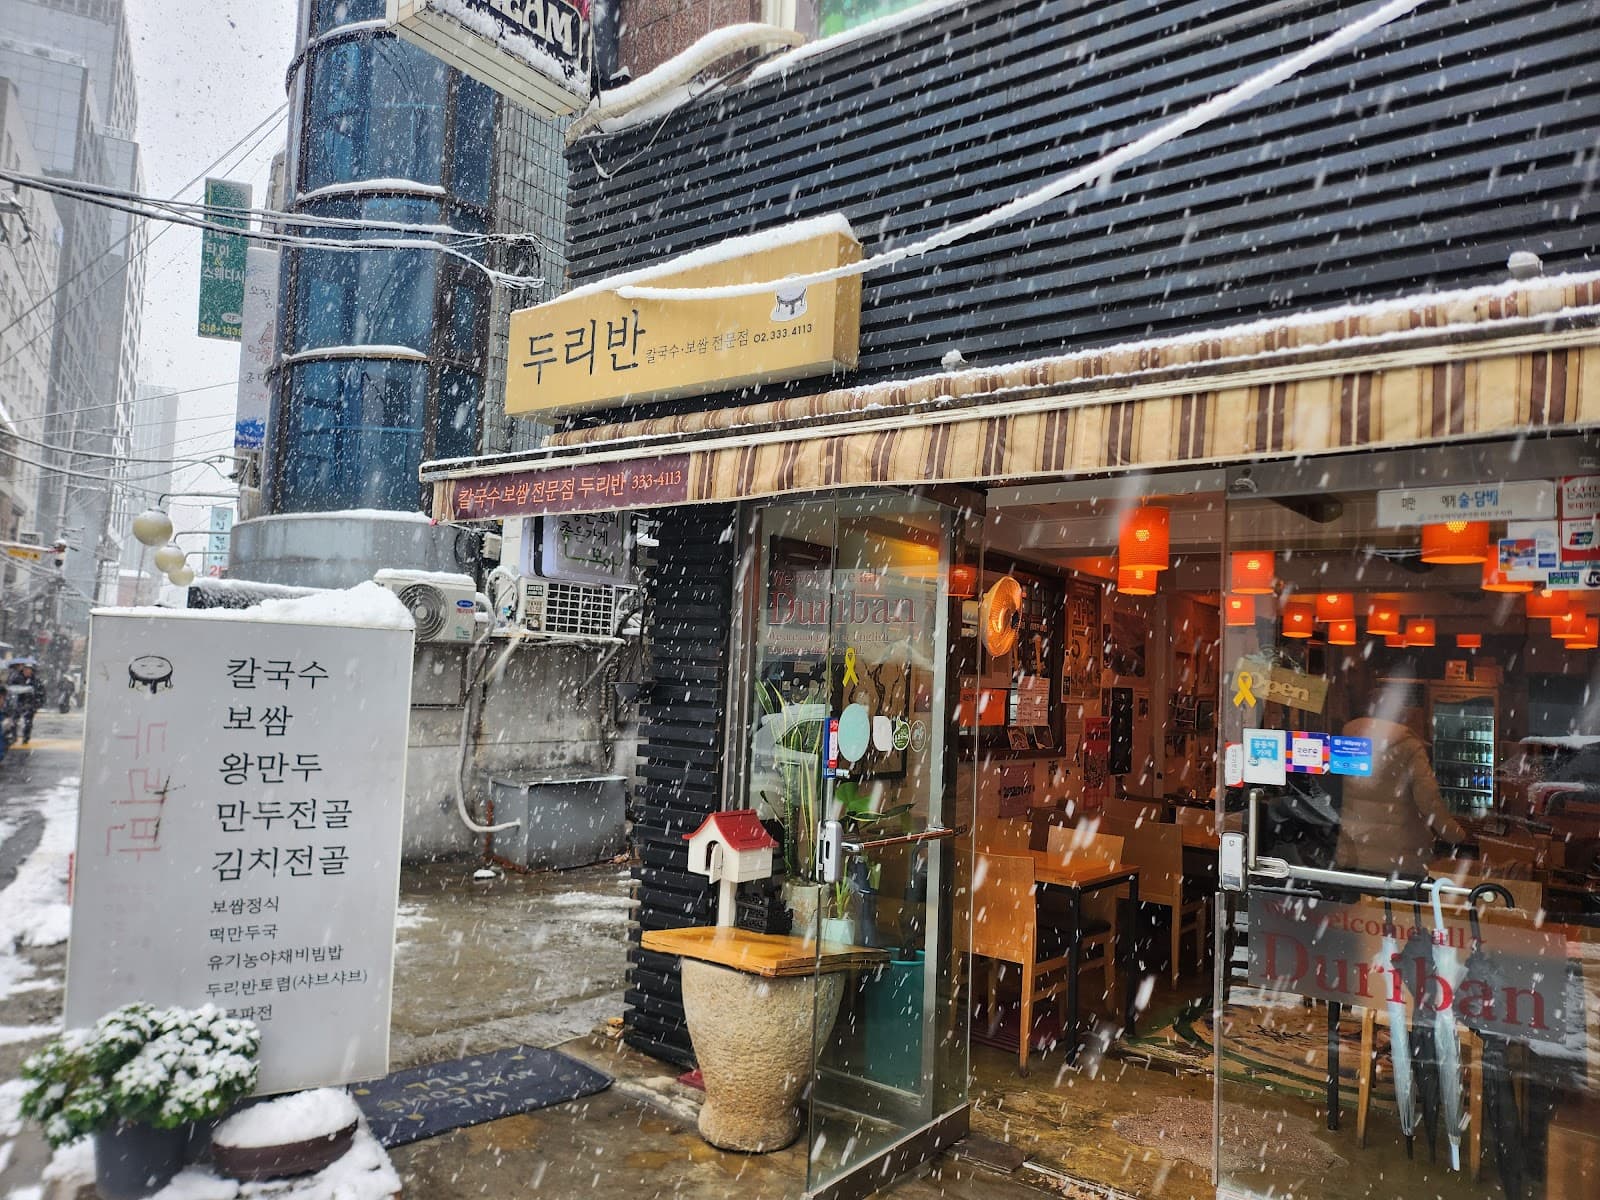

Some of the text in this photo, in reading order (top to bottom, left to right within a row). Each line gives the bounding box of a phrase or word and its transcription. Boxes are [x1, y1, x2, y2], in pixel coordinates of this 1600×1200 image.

[523, 309, 646, 384] 두리반
[712, 329, 749, 352] 전문점
[753, 323, 813, 343] 02.333.4113
[458, 471, 681, 509] 칼국수 보쌈 전문점 두리반 333-4113
[768, 591, 917, 625] Duriban
[226, 656, 330, 690] 칼국수
[223, 705, 294, 737] 보쌈
[218, 753, 323, 785] 왕만두
[105, 716, 169, 862] 두리반
[216, 799, 353, 832] 만두전골
[212, 845, 350, 882] 김치전골
[212, 895, 280, 916] 보쌈정식
[209, 923, 279, 944] 떡만두국
[207, 944, 345, 972] 유기농야채비빔밥
[1259, 931, 1550, 1031] Duriban
